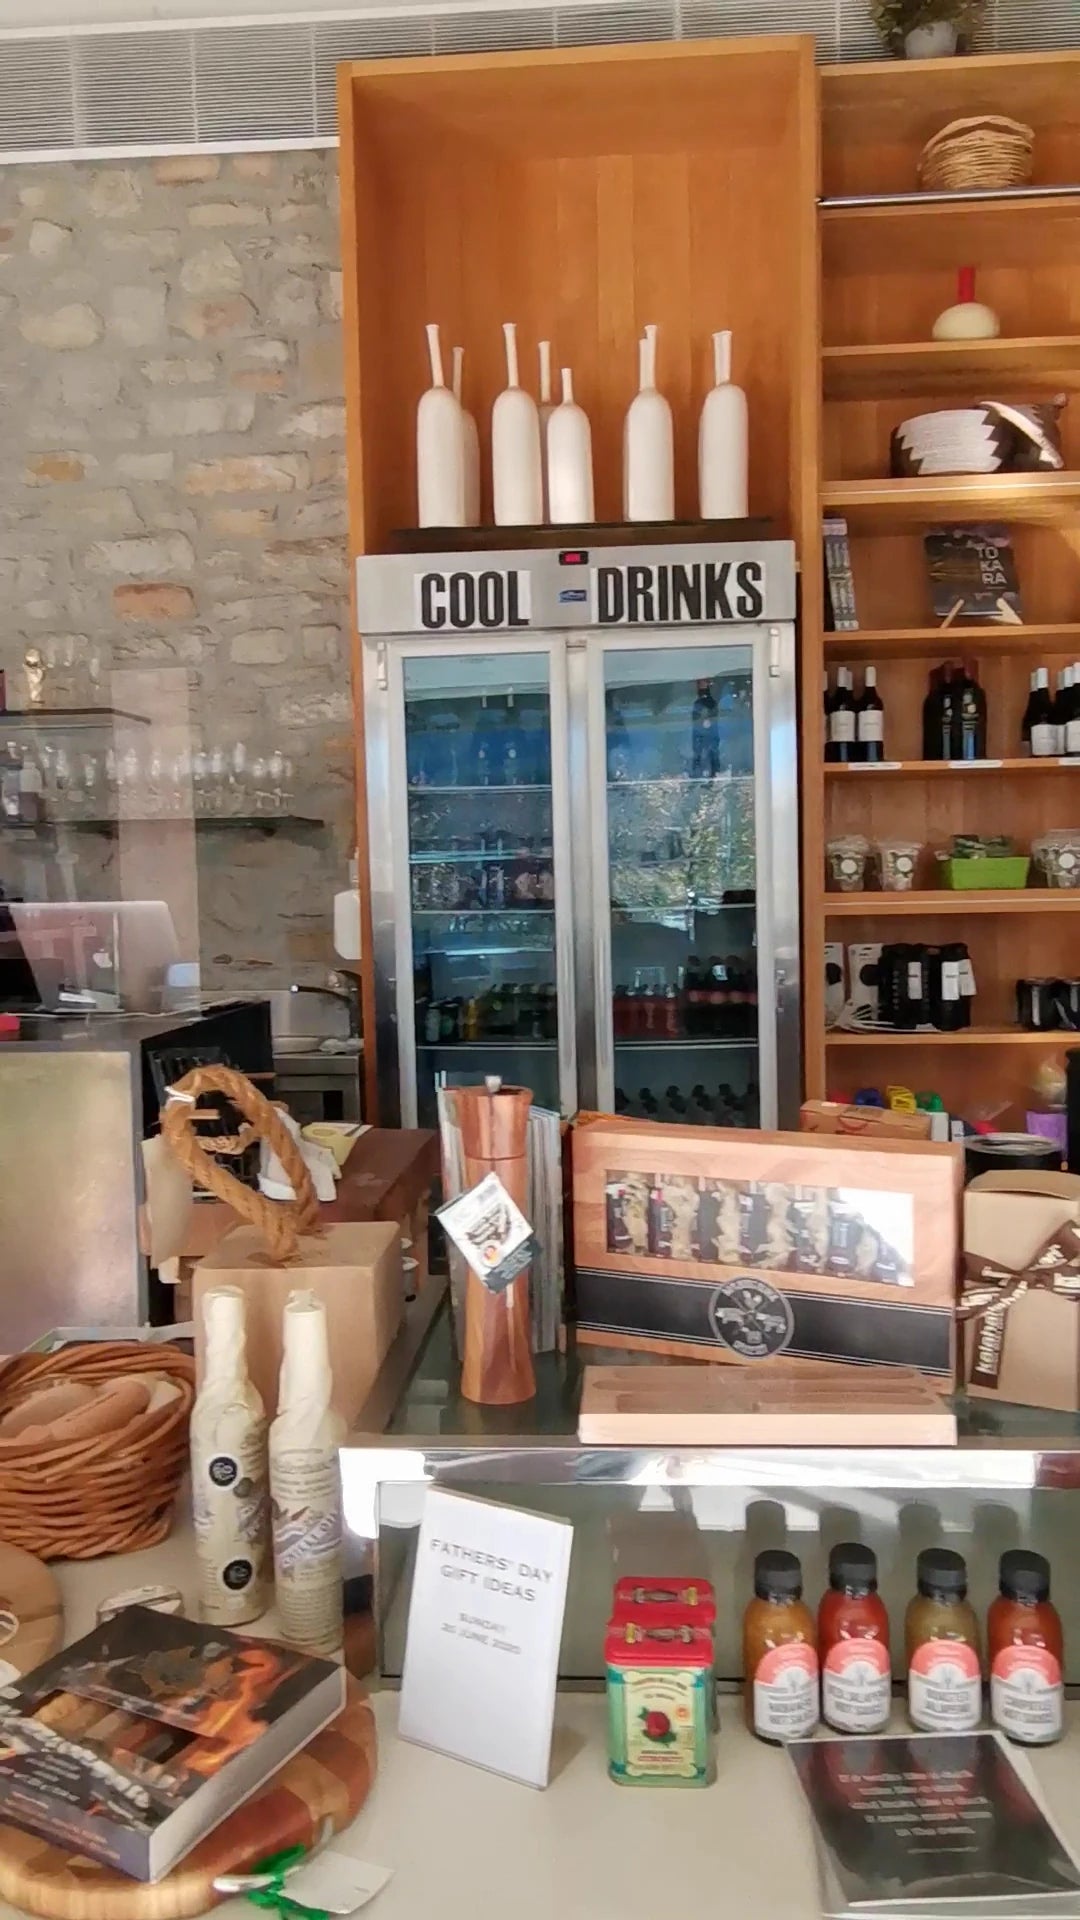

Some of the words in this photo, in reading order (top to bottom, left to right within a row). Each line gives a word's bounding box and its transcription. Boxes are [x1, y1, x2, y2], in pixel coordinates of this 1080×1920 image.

[975, 543, 999, 560] TO
[980, 560, 1005, 572] KA
[981, 572, 1008, 585] RA
[421, 571, 530, 629] COOL
[597, 562, 764, 624] DRINKS
[518, 1563, 553, 1583] DAY
[440, 1564, 478, 1585] GIFT
[483, 1576, 537, 1602] IDEAS
